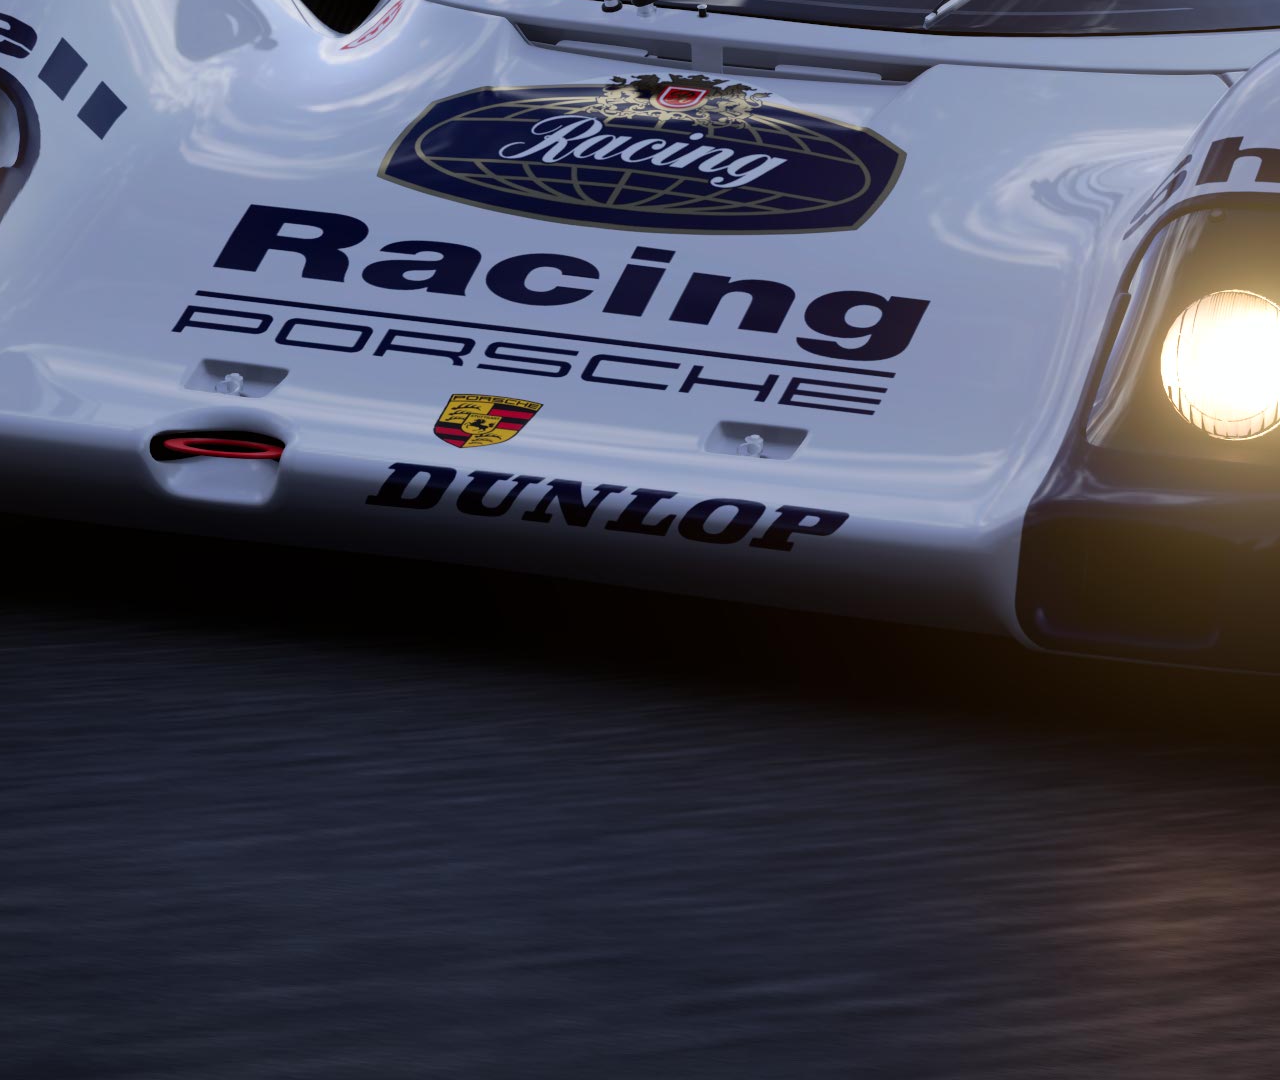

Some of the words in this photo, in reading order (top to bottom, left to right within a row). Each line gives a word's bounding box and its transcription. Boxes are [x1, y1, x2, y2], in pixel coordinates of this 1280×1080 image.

[499, 115, 786, 189] Racing
[213, 203, 931, 362] Racing
[171, 305, 888, 416] PORSCHE
[453, 395, 540, 410] PORSCHE
[365, 461, 850, 552] DUNLOP
